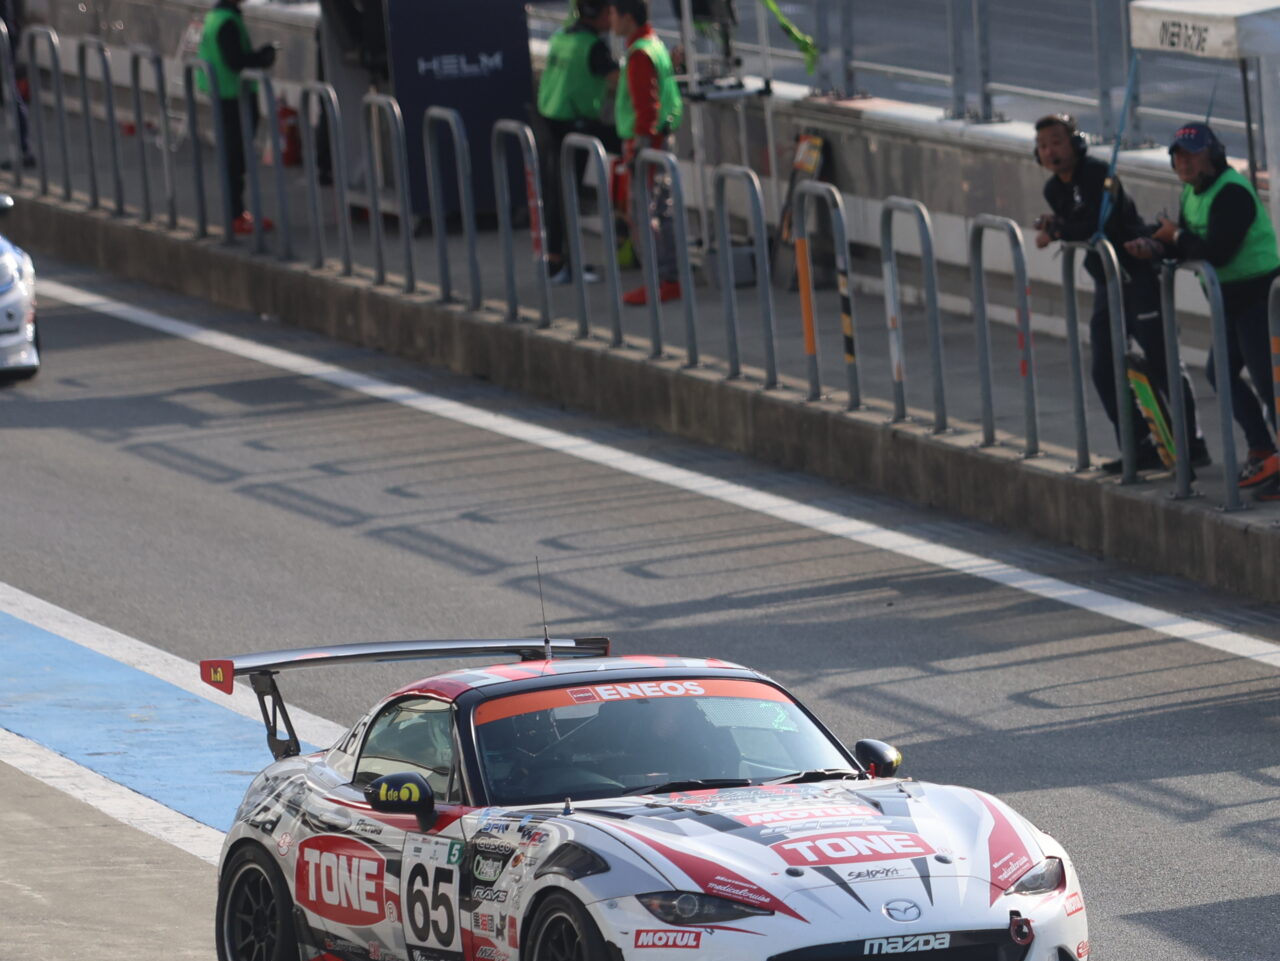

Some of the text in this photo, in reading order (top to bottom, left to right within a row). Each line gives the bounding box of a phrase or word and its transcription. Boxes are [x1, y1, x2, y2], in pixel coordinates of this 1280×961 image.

[417, 51, 503, 77] HELM
[595, 681, 705, 700] ENEOS
[750, 806, 872, 824] MOTUL
[450, 844, 460, 863] 5
[782, 834, 924, 862] TONE
[304, 847, 379, 914] TONE
[406, 862, 456, 948] 65
[637, 932, 697, 946] MOTUL
